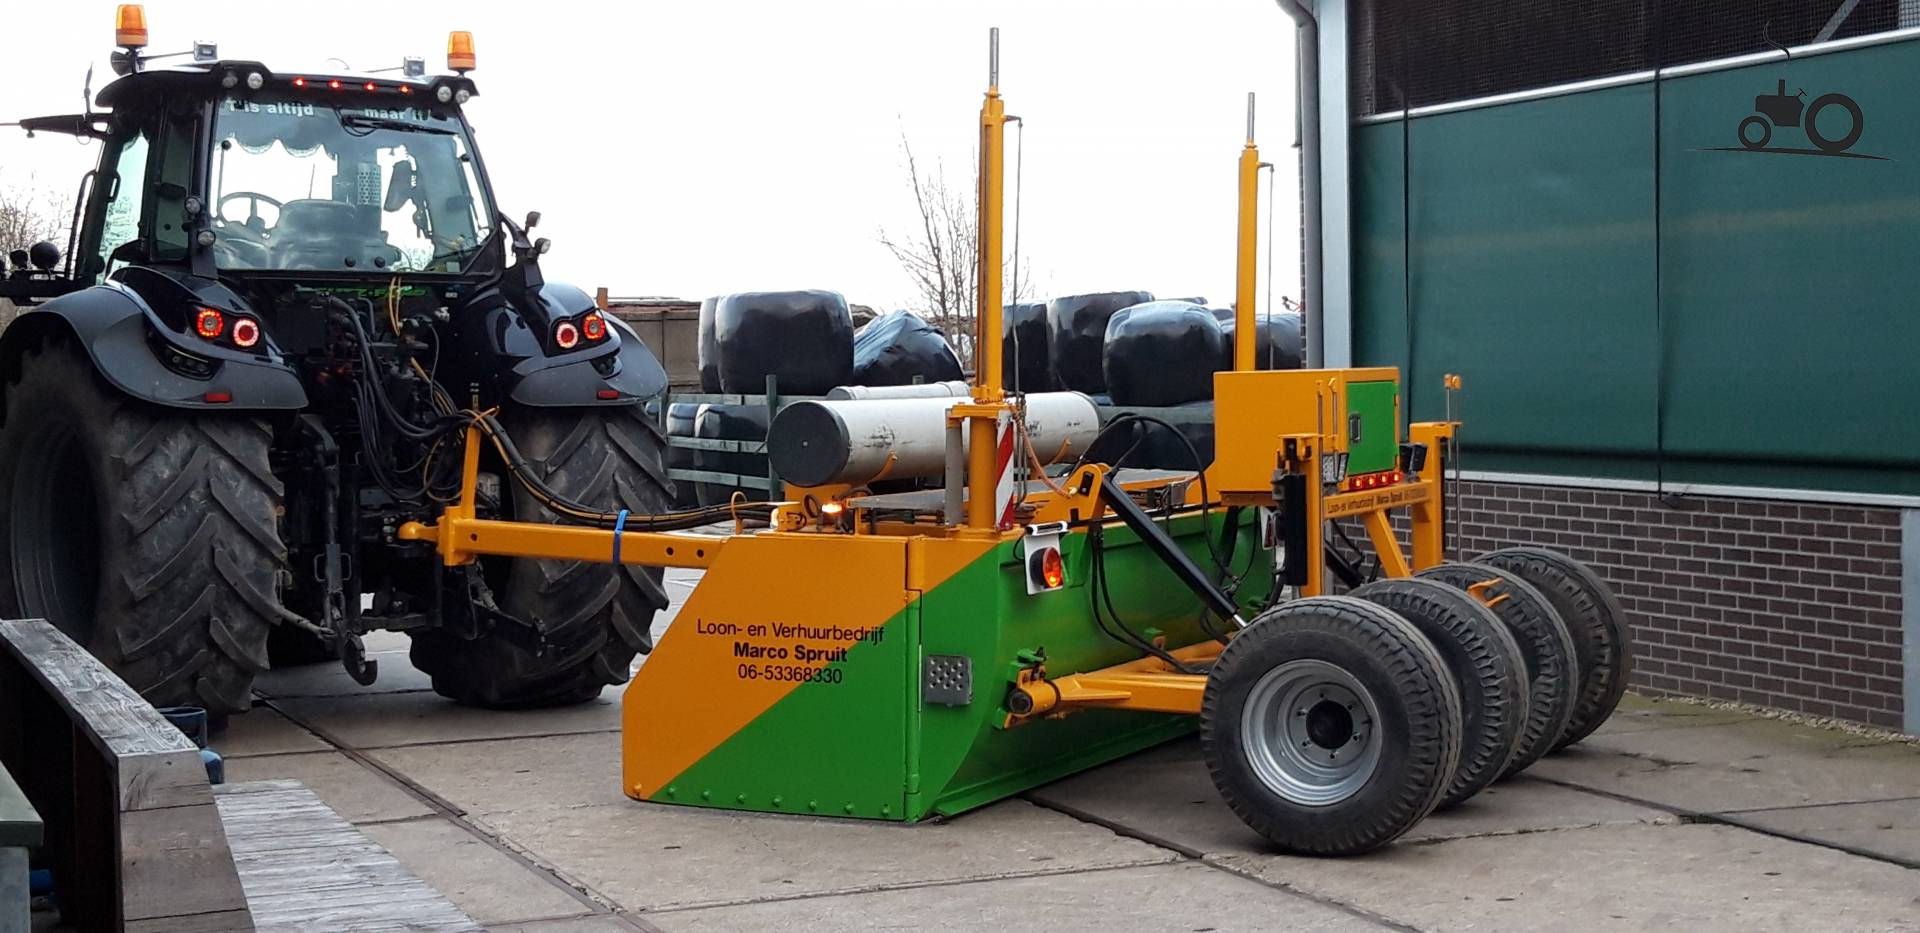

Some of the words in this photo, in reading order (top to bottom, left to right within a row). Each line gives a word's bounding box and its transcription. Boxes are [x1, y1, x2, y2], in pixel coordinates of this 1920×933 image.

[267, 102, 314, 117] altijd
[364, 108, 405, 119] maar
[697, 618, 743, 635] Loon-
[747, 624, 767, 637] en
[771, 622, 884, 646] Verhuurbedrijf
[734, 641, 788, 659] Marco
[794, 645, 847, 664] Spruit
[738, 663, 842, 684] 06-53368330
